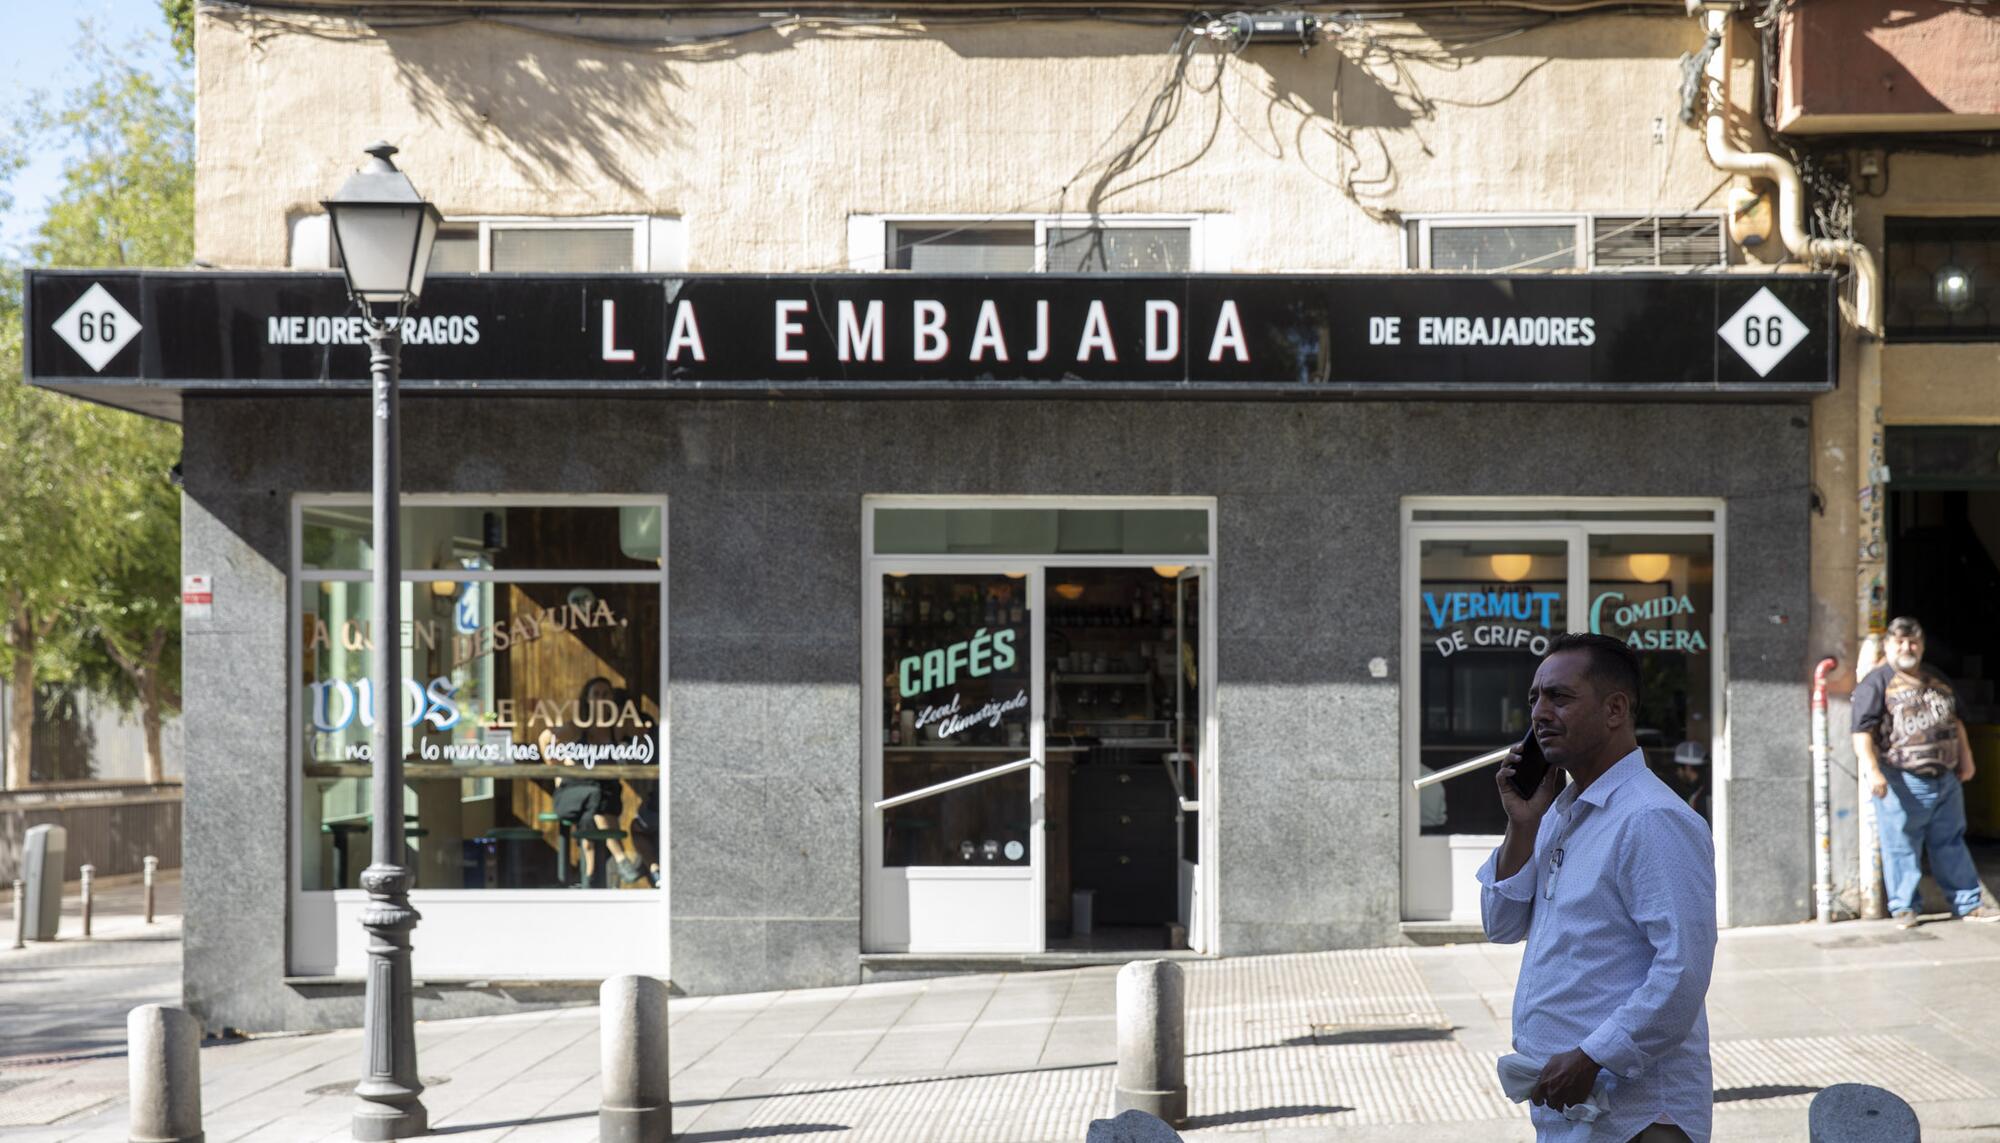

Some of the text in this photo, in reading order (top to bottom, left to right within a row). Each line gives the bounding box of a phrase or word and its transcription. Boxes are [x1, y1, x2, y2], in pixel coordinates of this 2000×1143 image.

[79, 311, 116, 343] 66
[268, 316, 381, 345] MEJORES
[602, 299, 1250, 363] LA EMBAJADA
[1369, 316, 1596, 347] DE EMBAJADORES
[1744, 315, 1783, 347] 66
[1422, 591, 1560, 630] VERMUT
[309, 619, 331, 649] A
[1435, 625, 1550, 657] DE GRIFO
[899, 627, 1016, 698] CAFÉS
[528, 699, 653, 729] AYUDA.
[915, 693, 960, 729] Local
[938, 689, 1028, 738] Climatizado
[420, 736, 440, 760] lo
[506, 735, 540, 761] has
